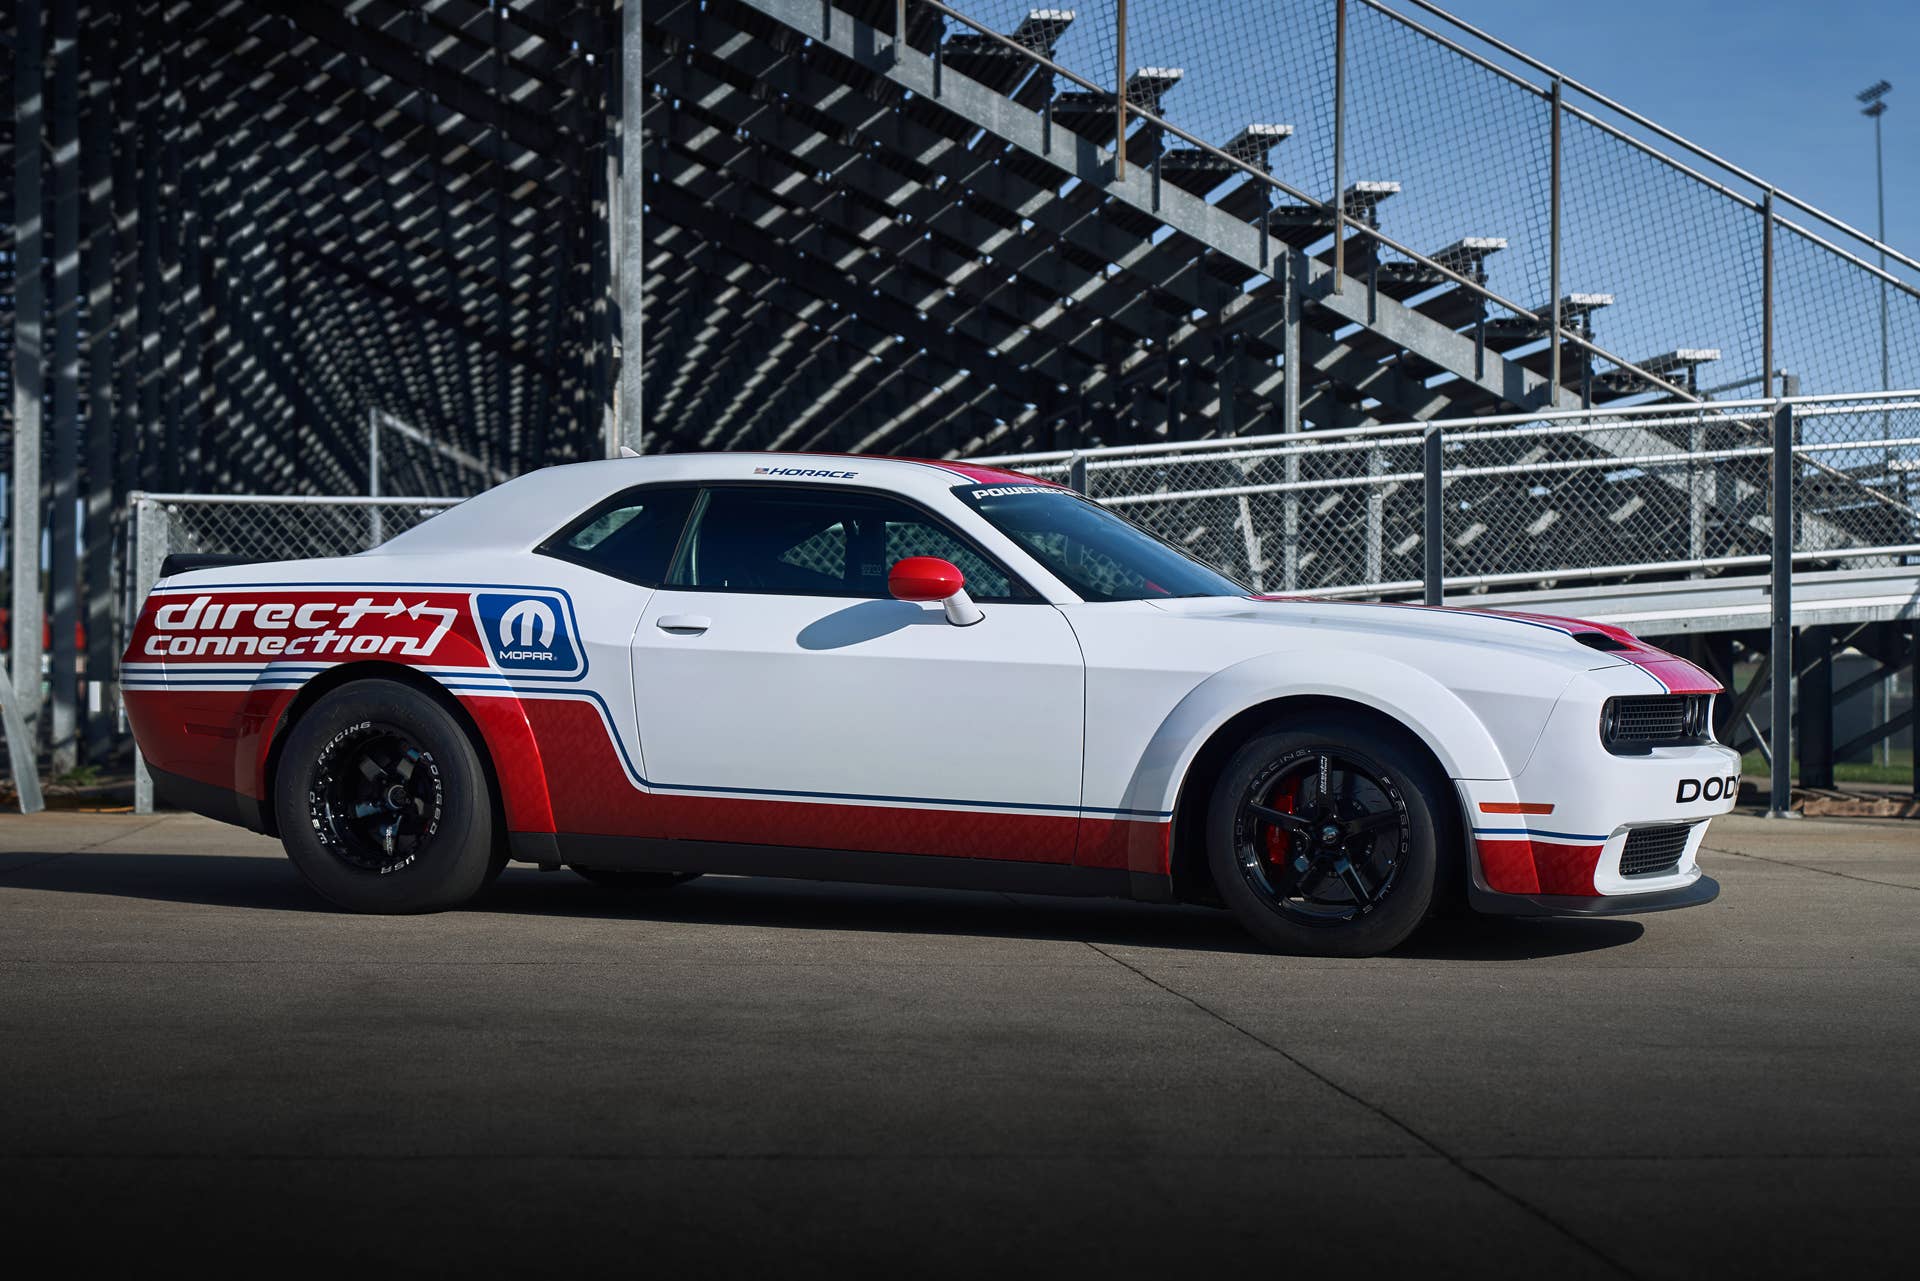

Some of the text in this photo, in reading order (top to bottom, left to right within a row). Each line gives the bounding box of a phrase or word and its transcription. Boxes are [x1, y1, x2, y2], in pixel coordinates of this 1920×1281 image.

[769, 467, 858, 479] HORACE
[155, 596, 408, 630] direct
[144, 631, 432, 657] connection
[499, 650, 553, 661] MOPAR
[318, 721, 371, 765] RACING
[424, 752, 443, 835] FORGED
[1676, 774, 1741, 803] DOD
[381, 854, 415, 874] USA
